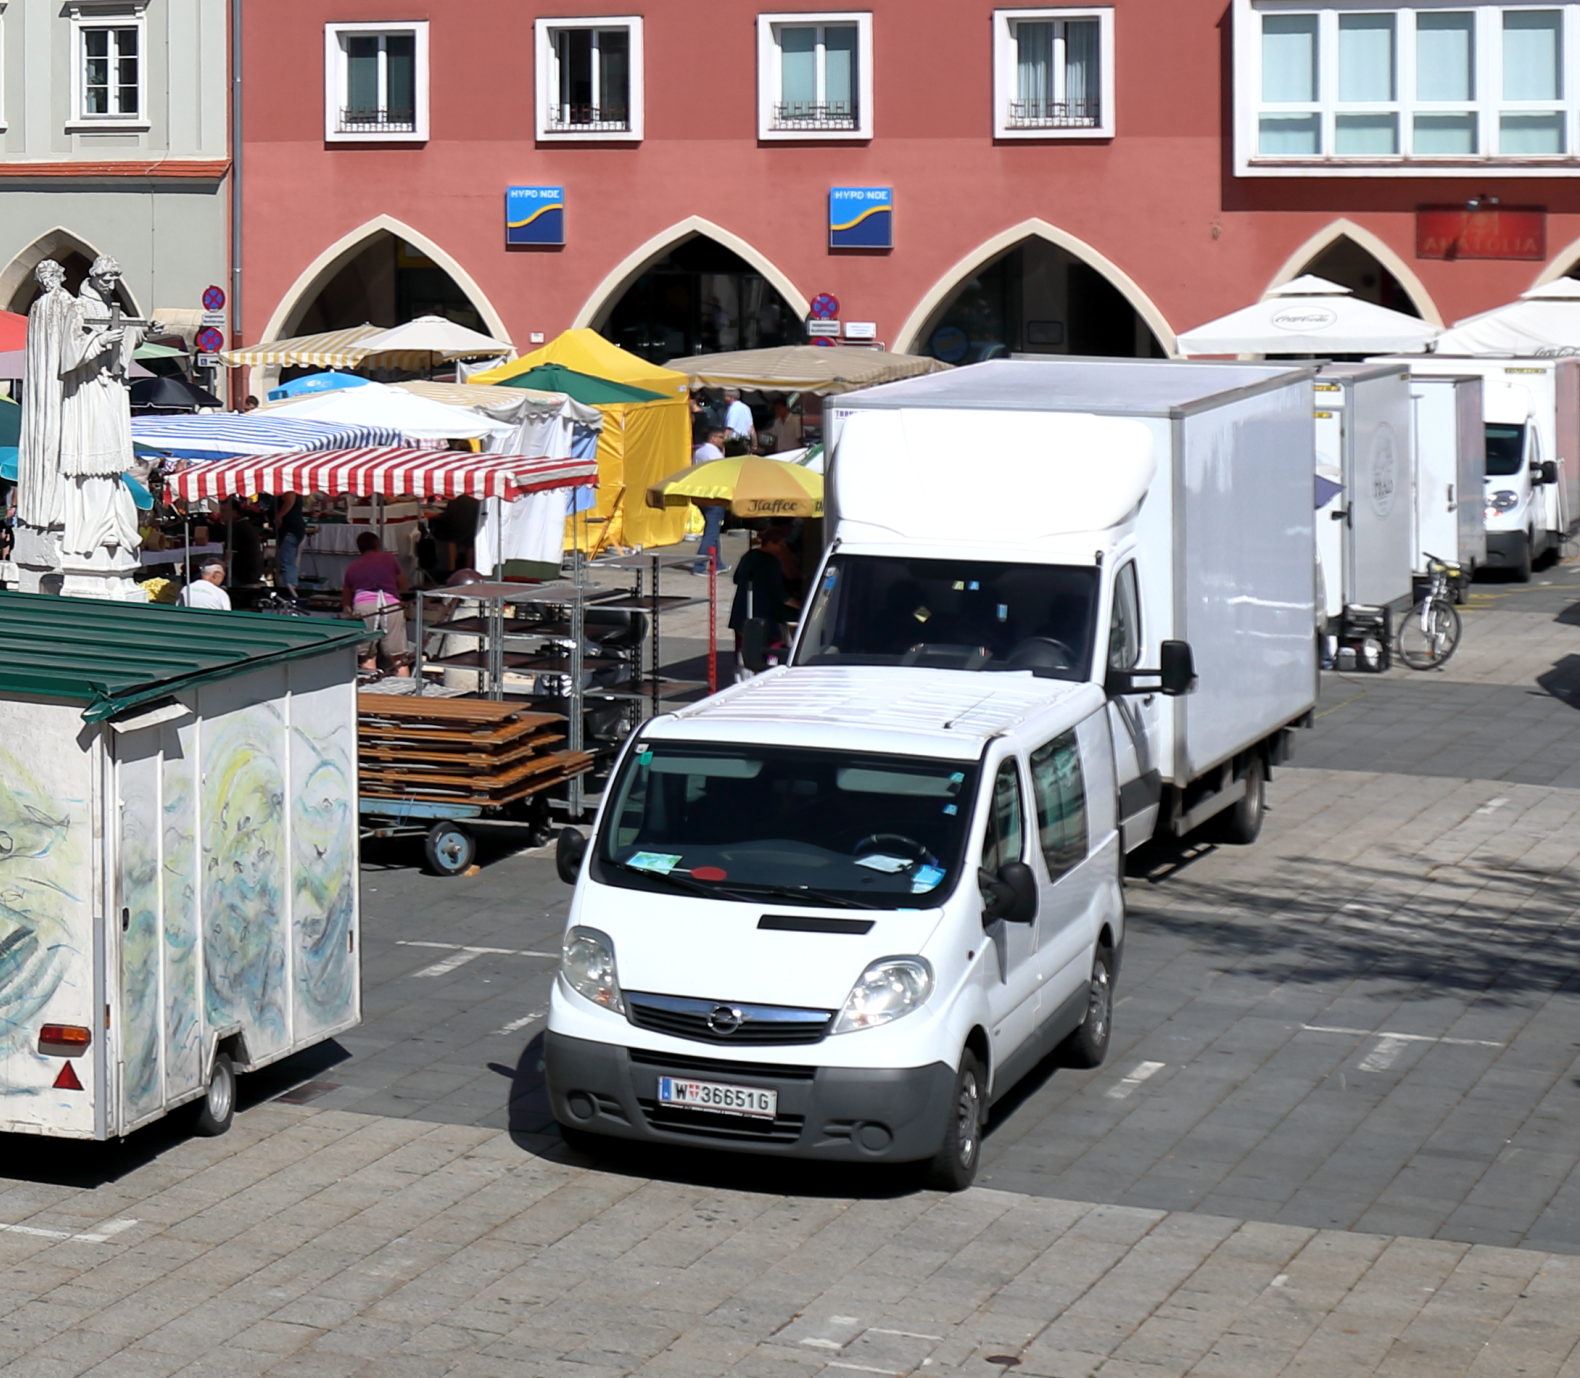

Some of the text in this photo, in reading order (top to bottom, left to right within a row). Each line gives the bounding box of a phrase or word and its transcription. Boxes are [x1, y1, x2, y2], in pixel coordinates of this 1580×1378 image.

[511, 189, 538, 198] HYPO
[835, 191, 864, 200] HYPO
[748, 499, 798, 513] Kaffee
[674, 1082, 688, 1100] W
